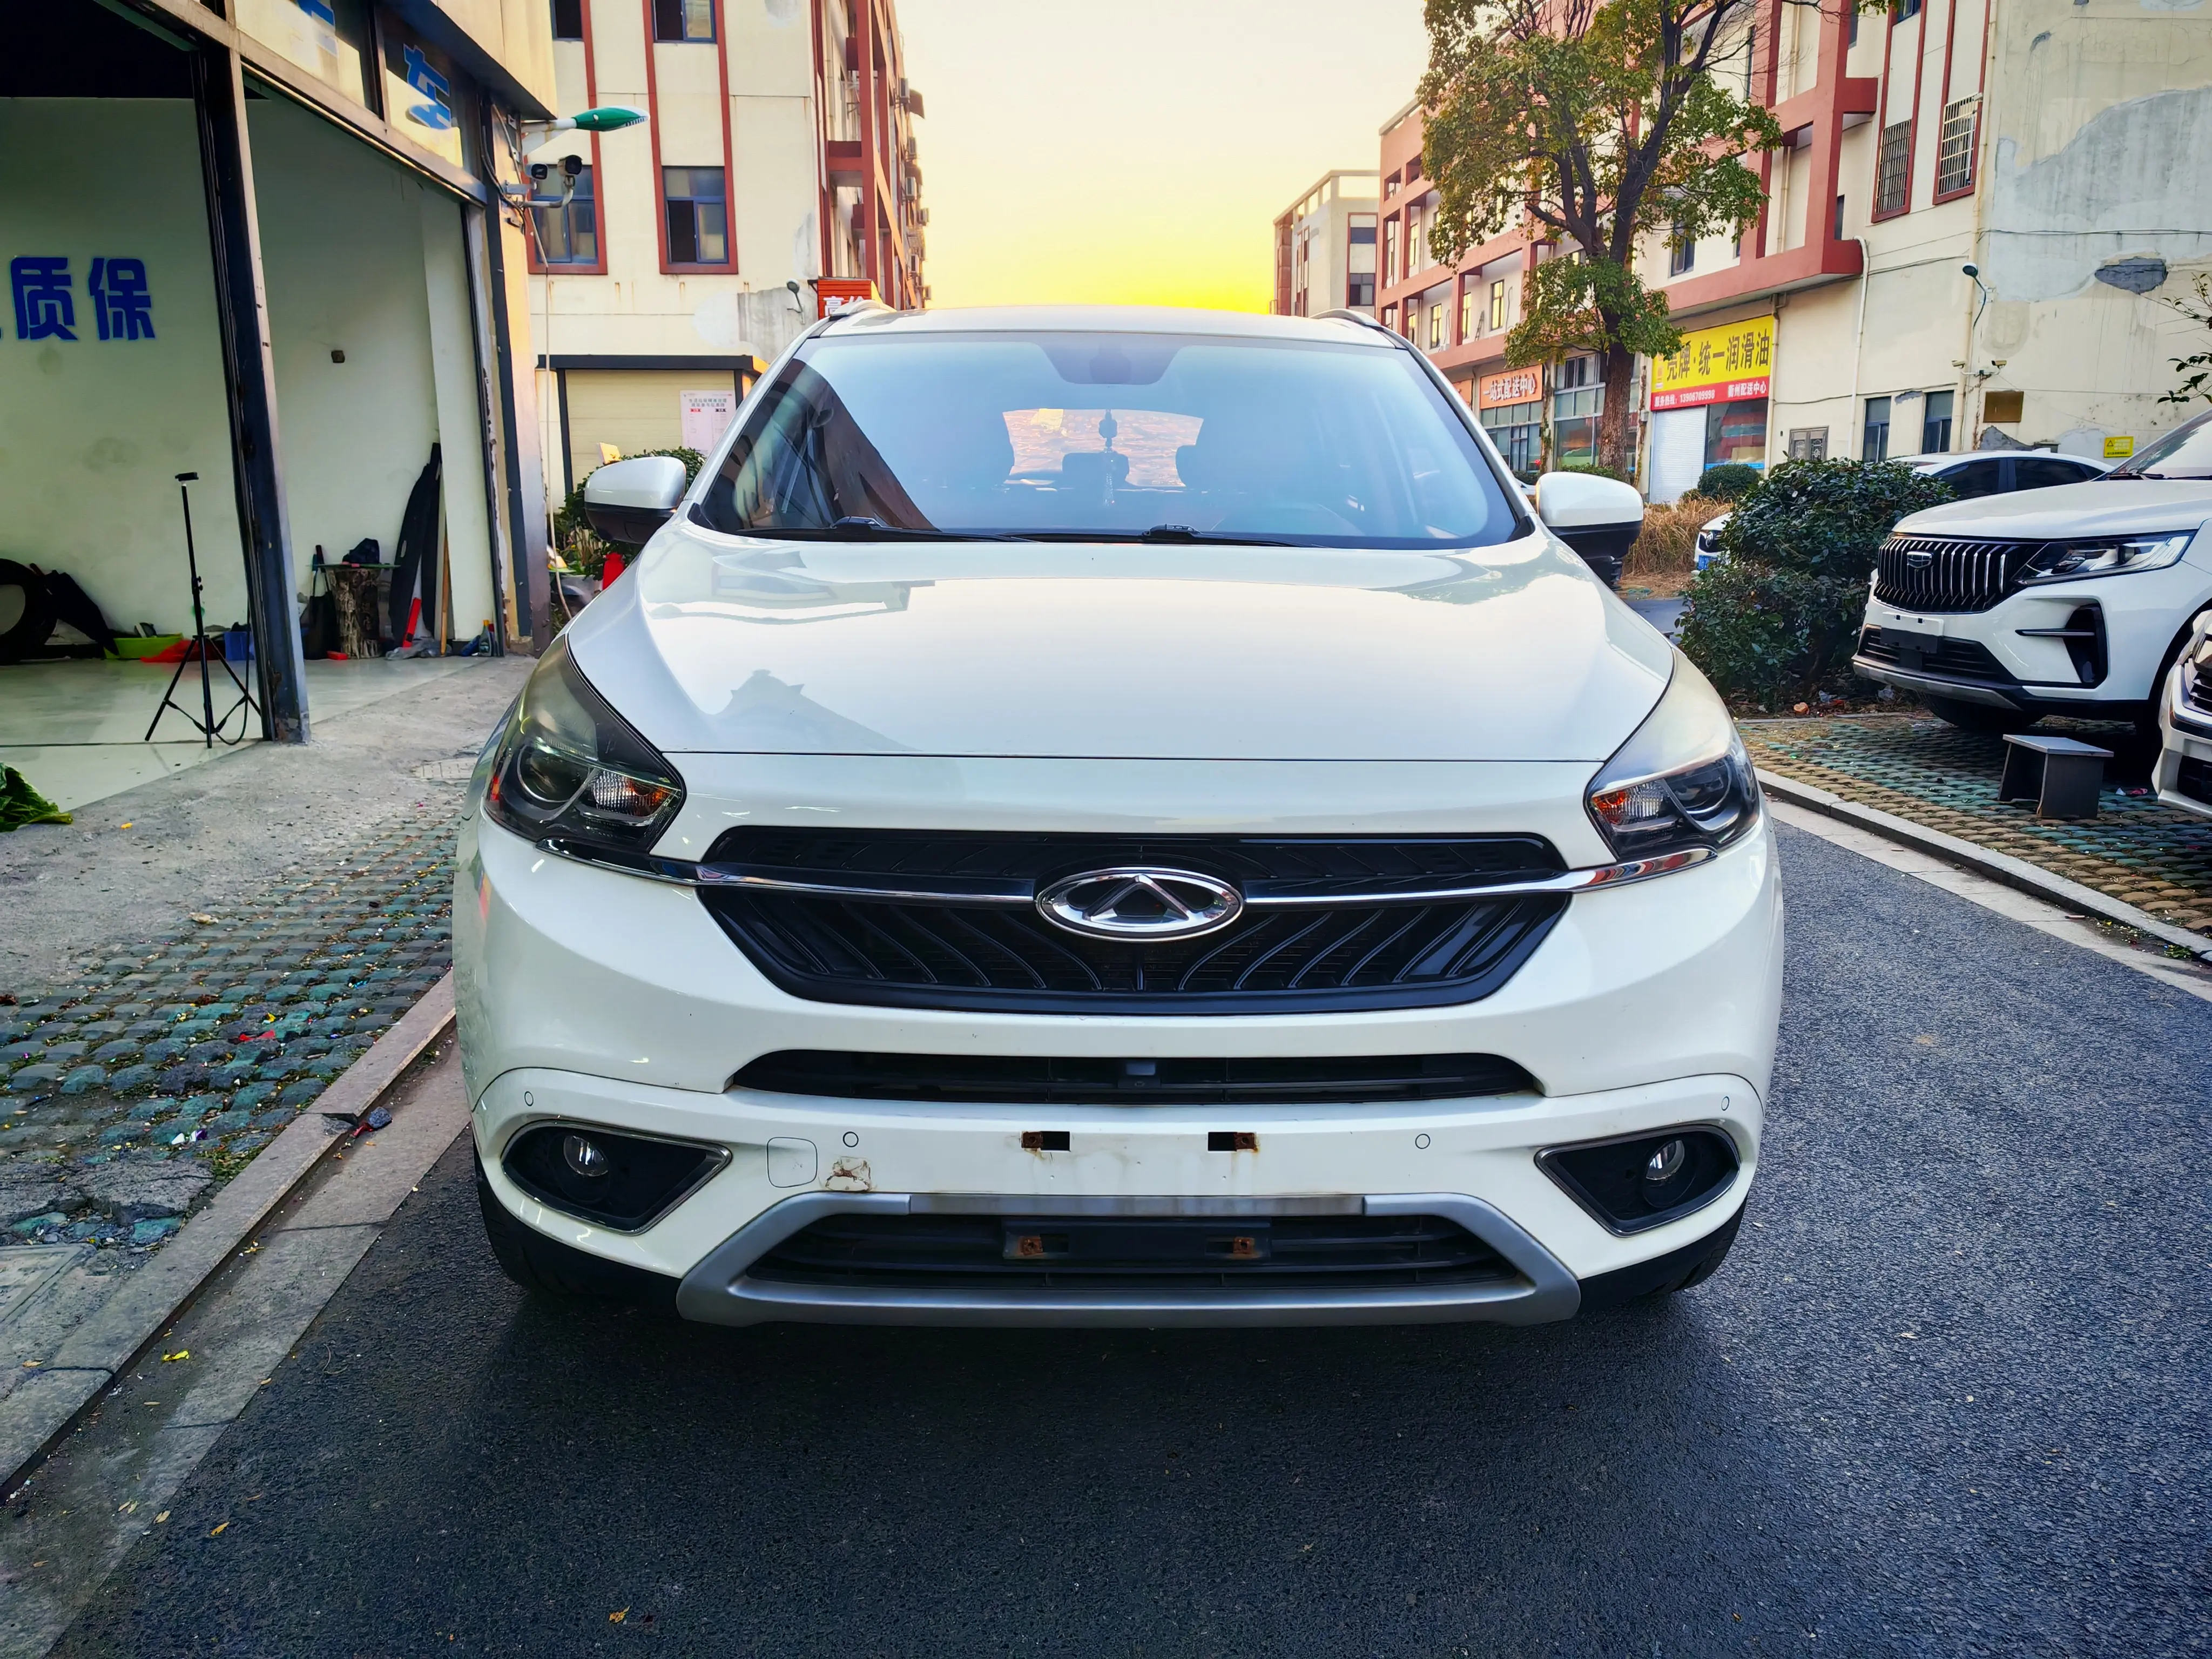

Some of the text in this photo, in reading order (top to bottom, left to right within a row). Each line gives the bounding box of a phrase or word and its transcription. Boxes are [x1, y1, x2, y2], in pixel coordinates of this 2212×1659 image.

[10, 257, 156, 341] 质保
[823, 295, 866, 318] 高
[1482, 373, 1537, 402] 一站式配送中心
